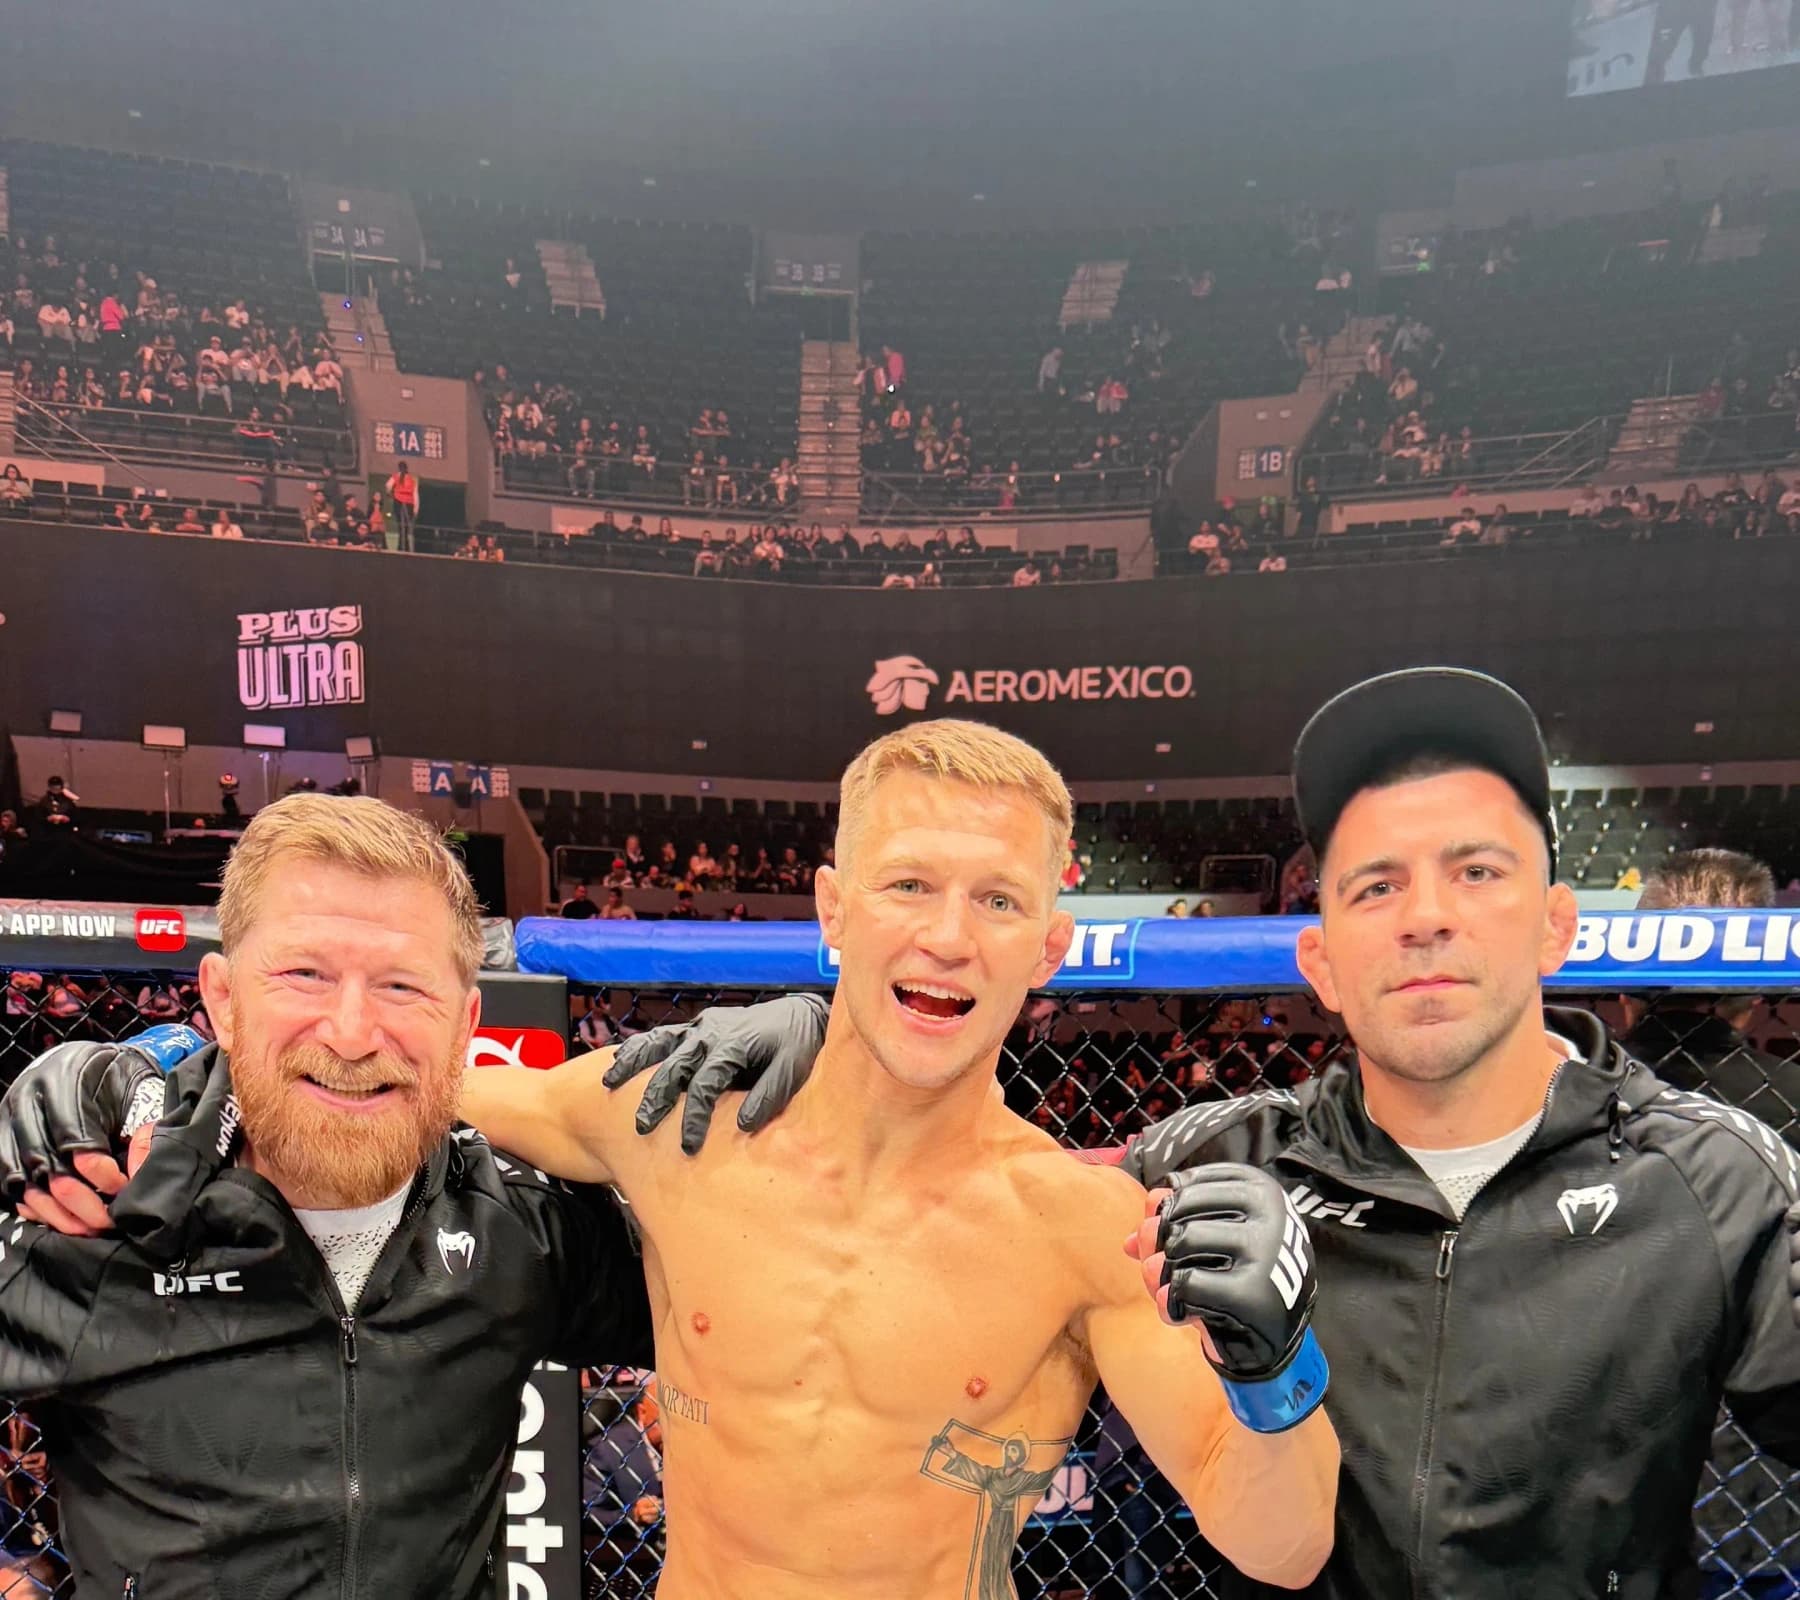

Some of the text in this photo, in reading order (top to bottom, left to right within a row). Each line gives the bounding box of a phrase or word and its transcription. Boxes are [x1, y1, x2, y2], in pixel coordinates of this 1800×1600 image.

[399, 430, 420, 451] 1A
[1260, 452, 1282, 472] 1B
[237, 604, 362, 645] PLUS
[237, 640, 365, 710] ULTRA
[945, 665, 1197, 703] AEROMEXICO
[434, 772, 452, 792] A
[10, 913, 56, 936] APP
[62, 915, 116, 937] NOW
[140, 919, 181, 935] UFC
[1565, 915, 1800, 962] BUD LI
[1288, 1184, 1376, 1228] UFC
[152, 1270, 244, 1296] UFC
